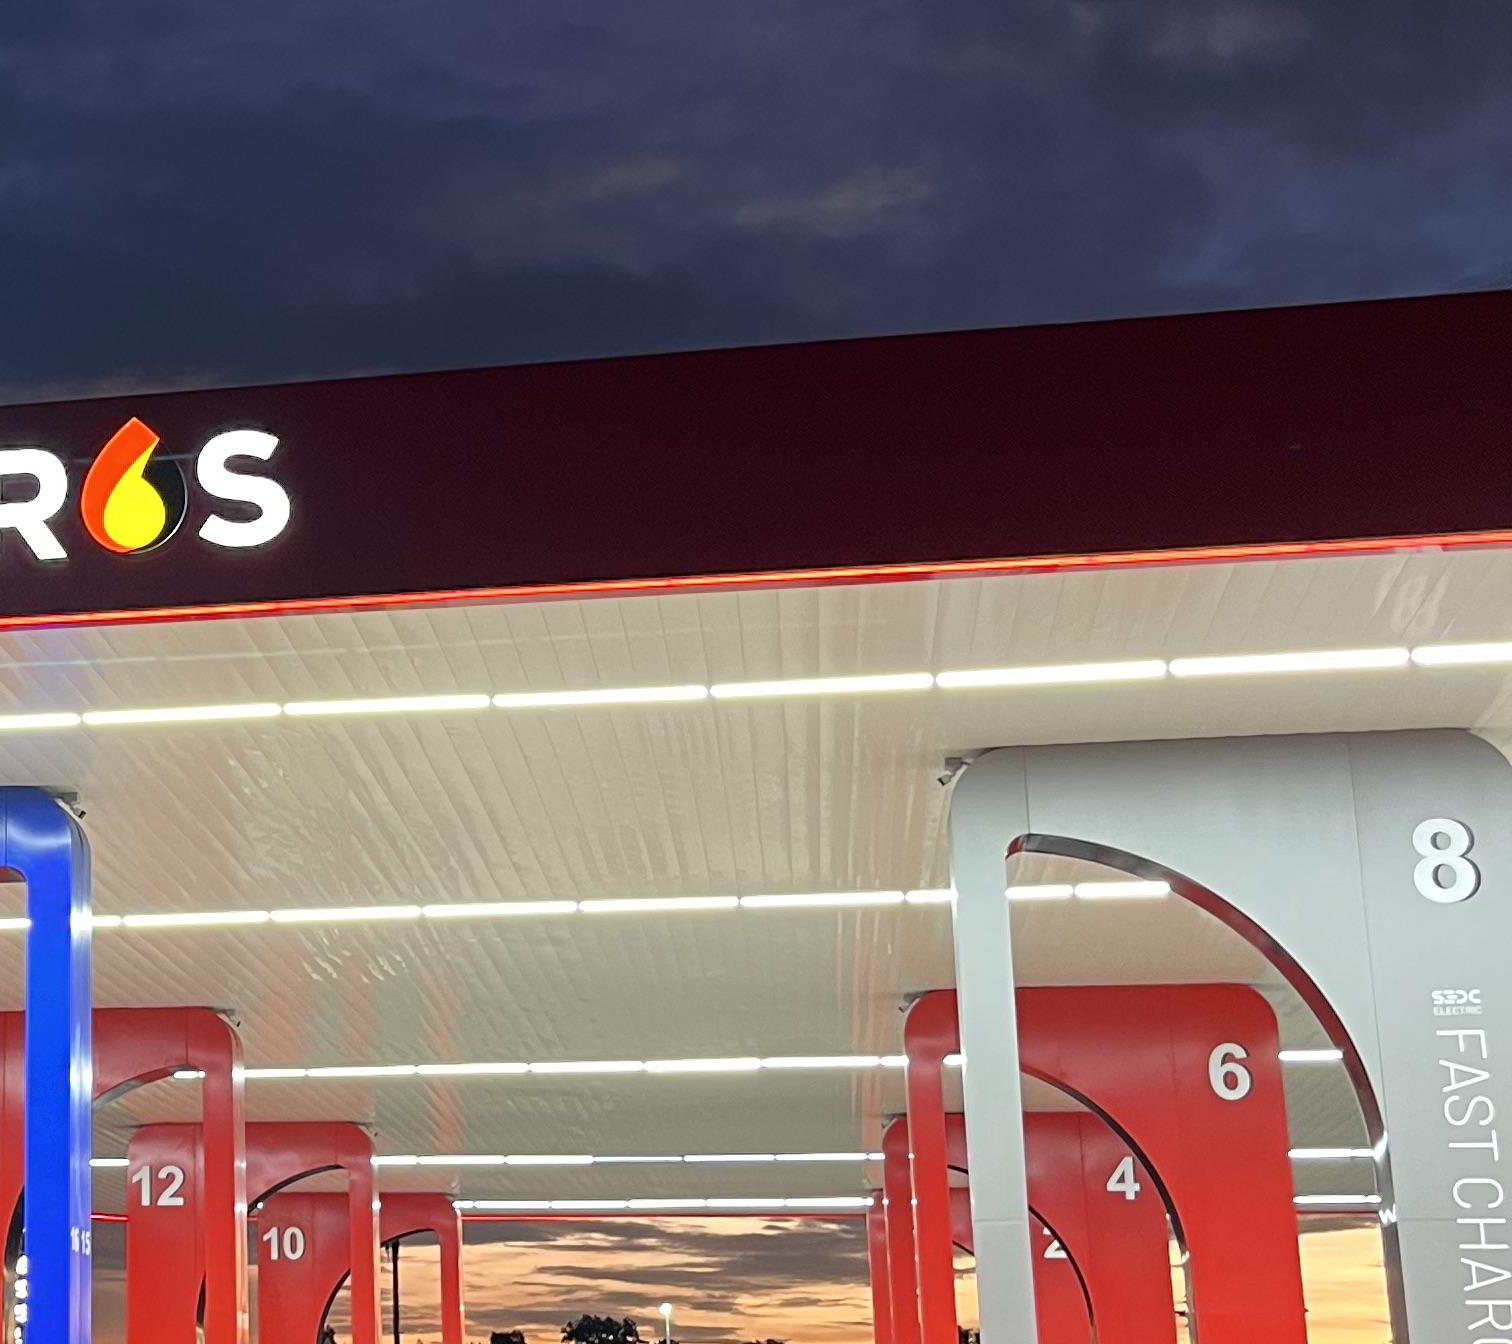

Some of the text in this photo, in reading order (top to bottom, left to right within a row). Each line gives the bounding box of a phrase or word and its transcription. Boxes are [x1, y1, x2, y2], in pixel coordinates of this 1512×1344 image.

[1412, 818, 1481, 903] 8
[1208, 1042, 1252, 1101] 6
[1435, 1028, 1500, 1161] FAST
[132, 1165, 185, 1207] 12
[1106, 1156, 1141, 1201] 4
[262, 1226, 305, 1261] 10
